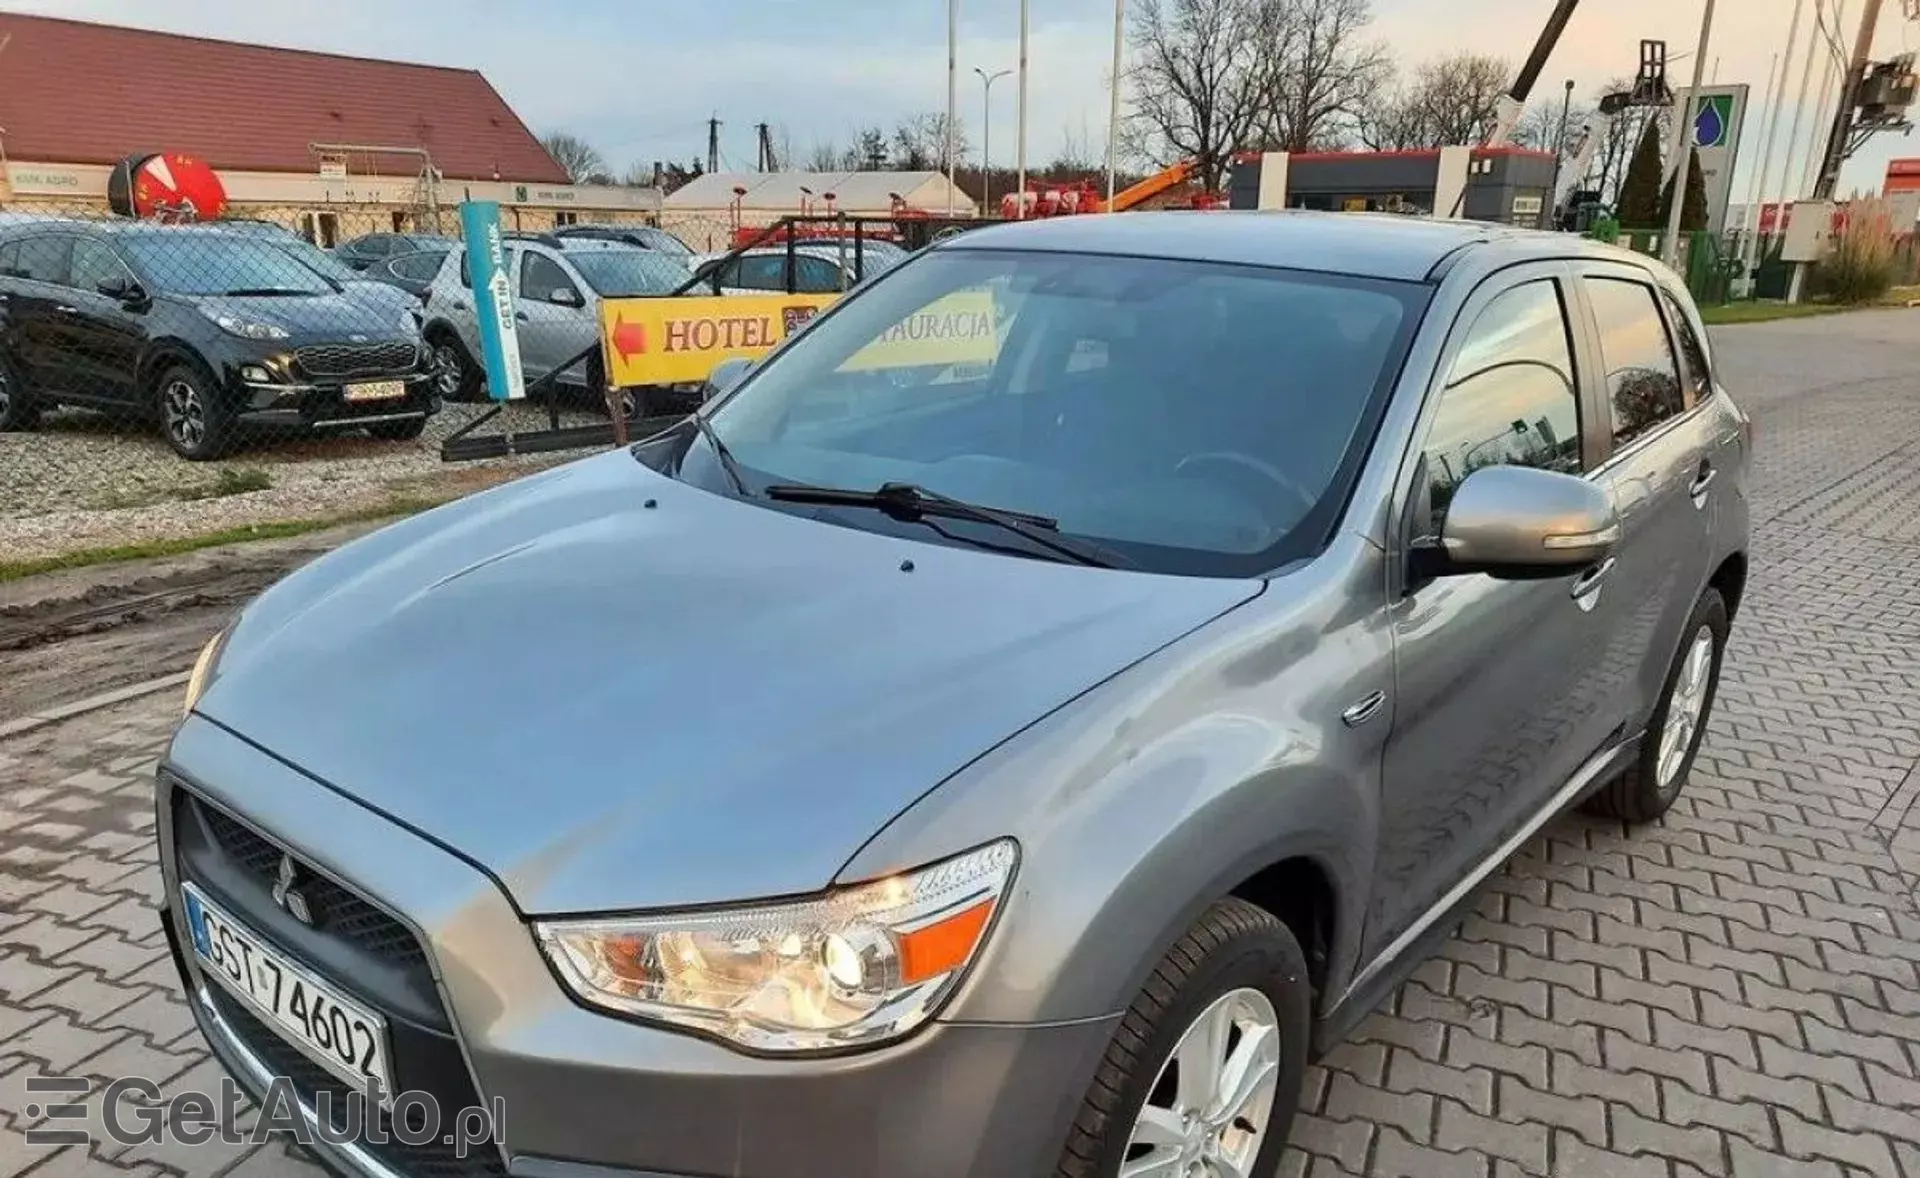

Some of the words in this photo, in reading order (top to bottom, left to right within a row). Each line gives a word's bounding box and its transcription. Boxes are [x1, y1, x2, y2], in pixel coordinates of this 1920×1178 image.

[487, 221, 502, 264] BANK
[663, 316, 777, 353] HOTEL
[203, 911, 255, 996] GST
[263, 957, 384, 1086] 74602
